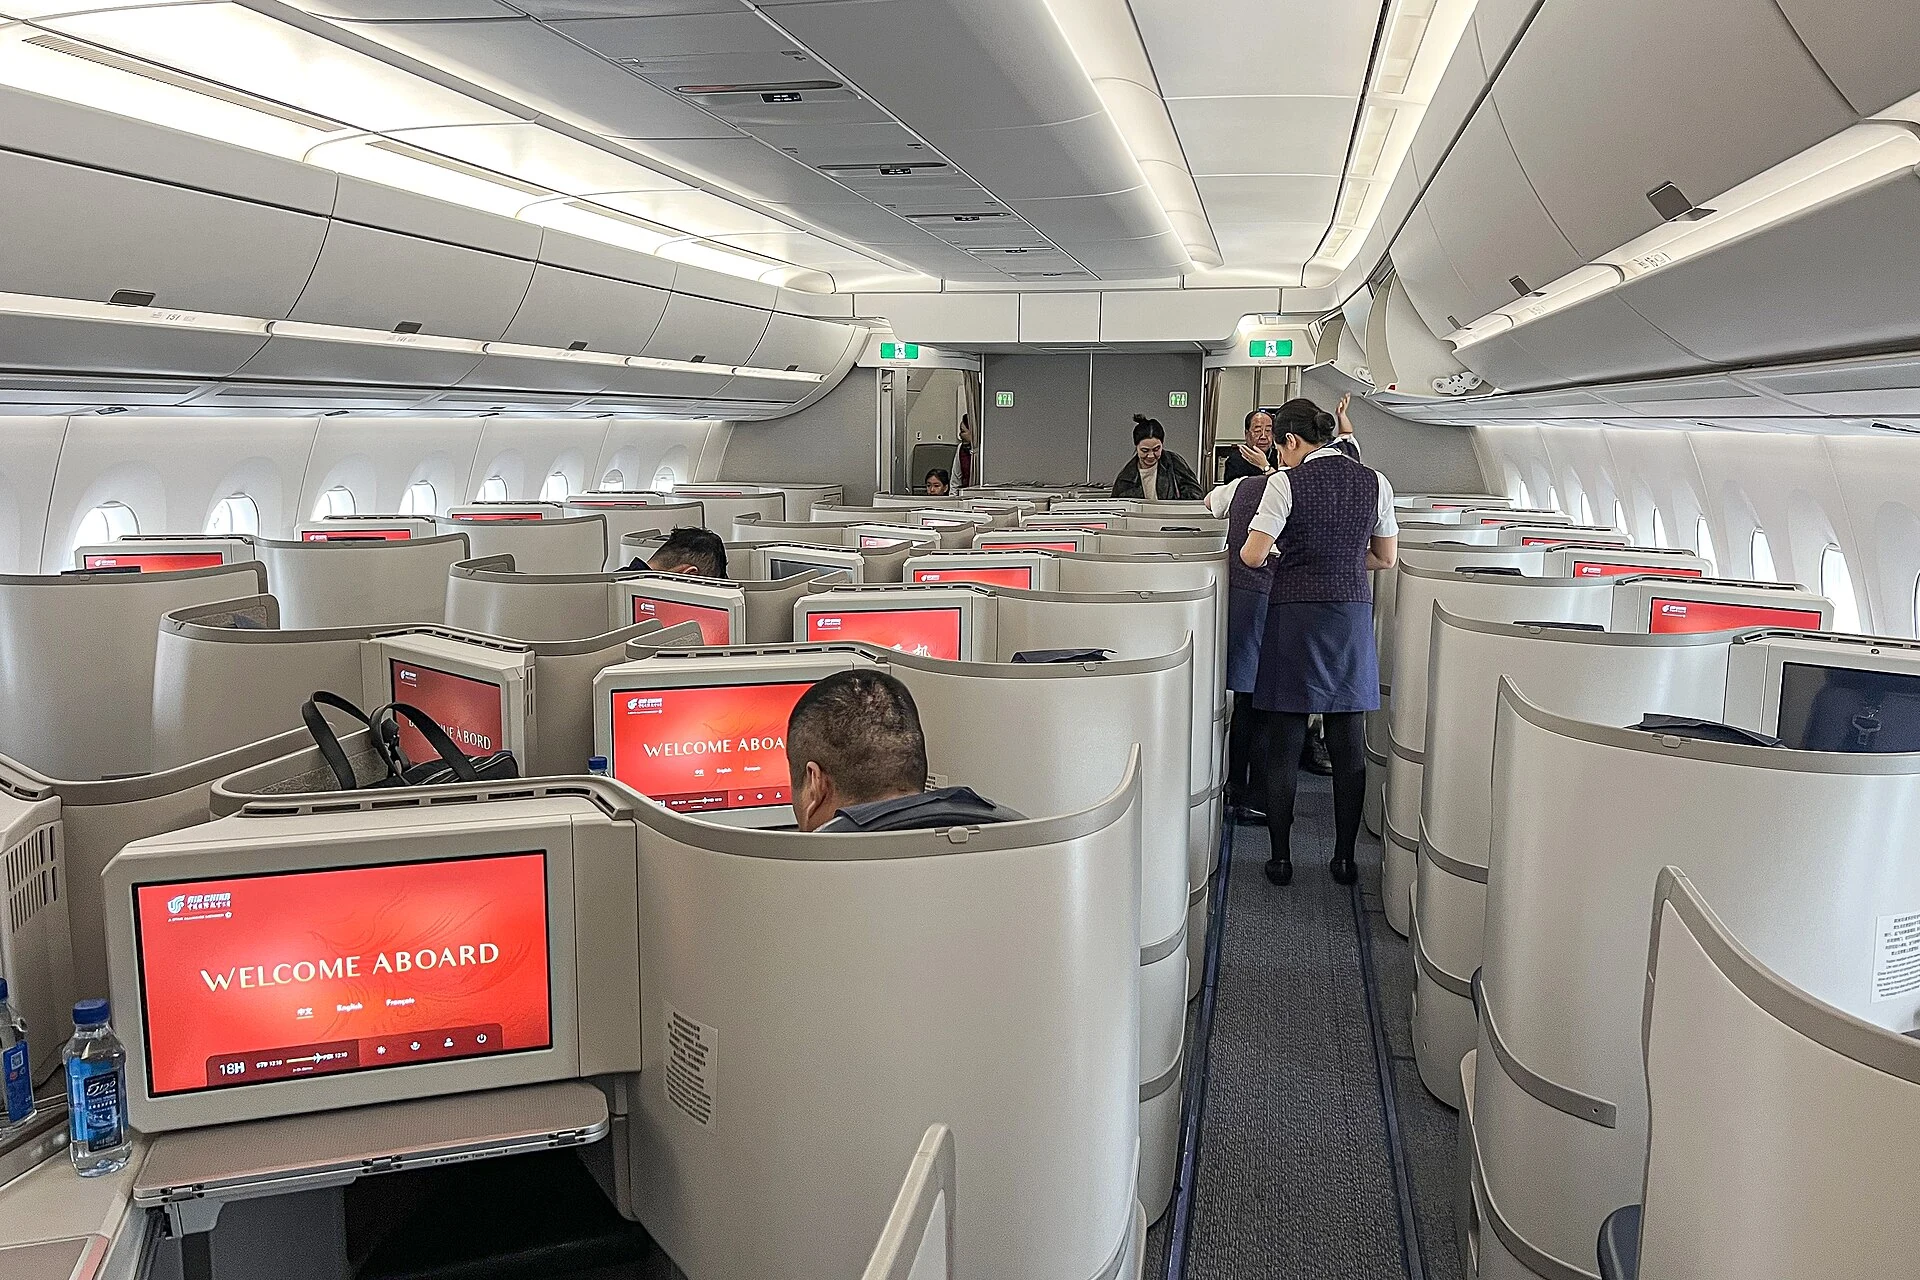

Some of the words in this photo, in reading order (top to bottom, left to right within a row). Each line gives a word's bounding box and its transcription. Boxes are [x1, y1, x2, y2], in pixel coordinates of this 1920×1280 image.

[463, 730, 491, 750] BORD
[643, 739, 732, 758] WELCOME
[737, 736, 785, 752] ABOA
[201, 955, 361, 992] WELCOME
[372, 943, 500, 975] ABOARD
[336, 1002, 363, 1012] English
[219, 1061, 246, 1076] 18H
